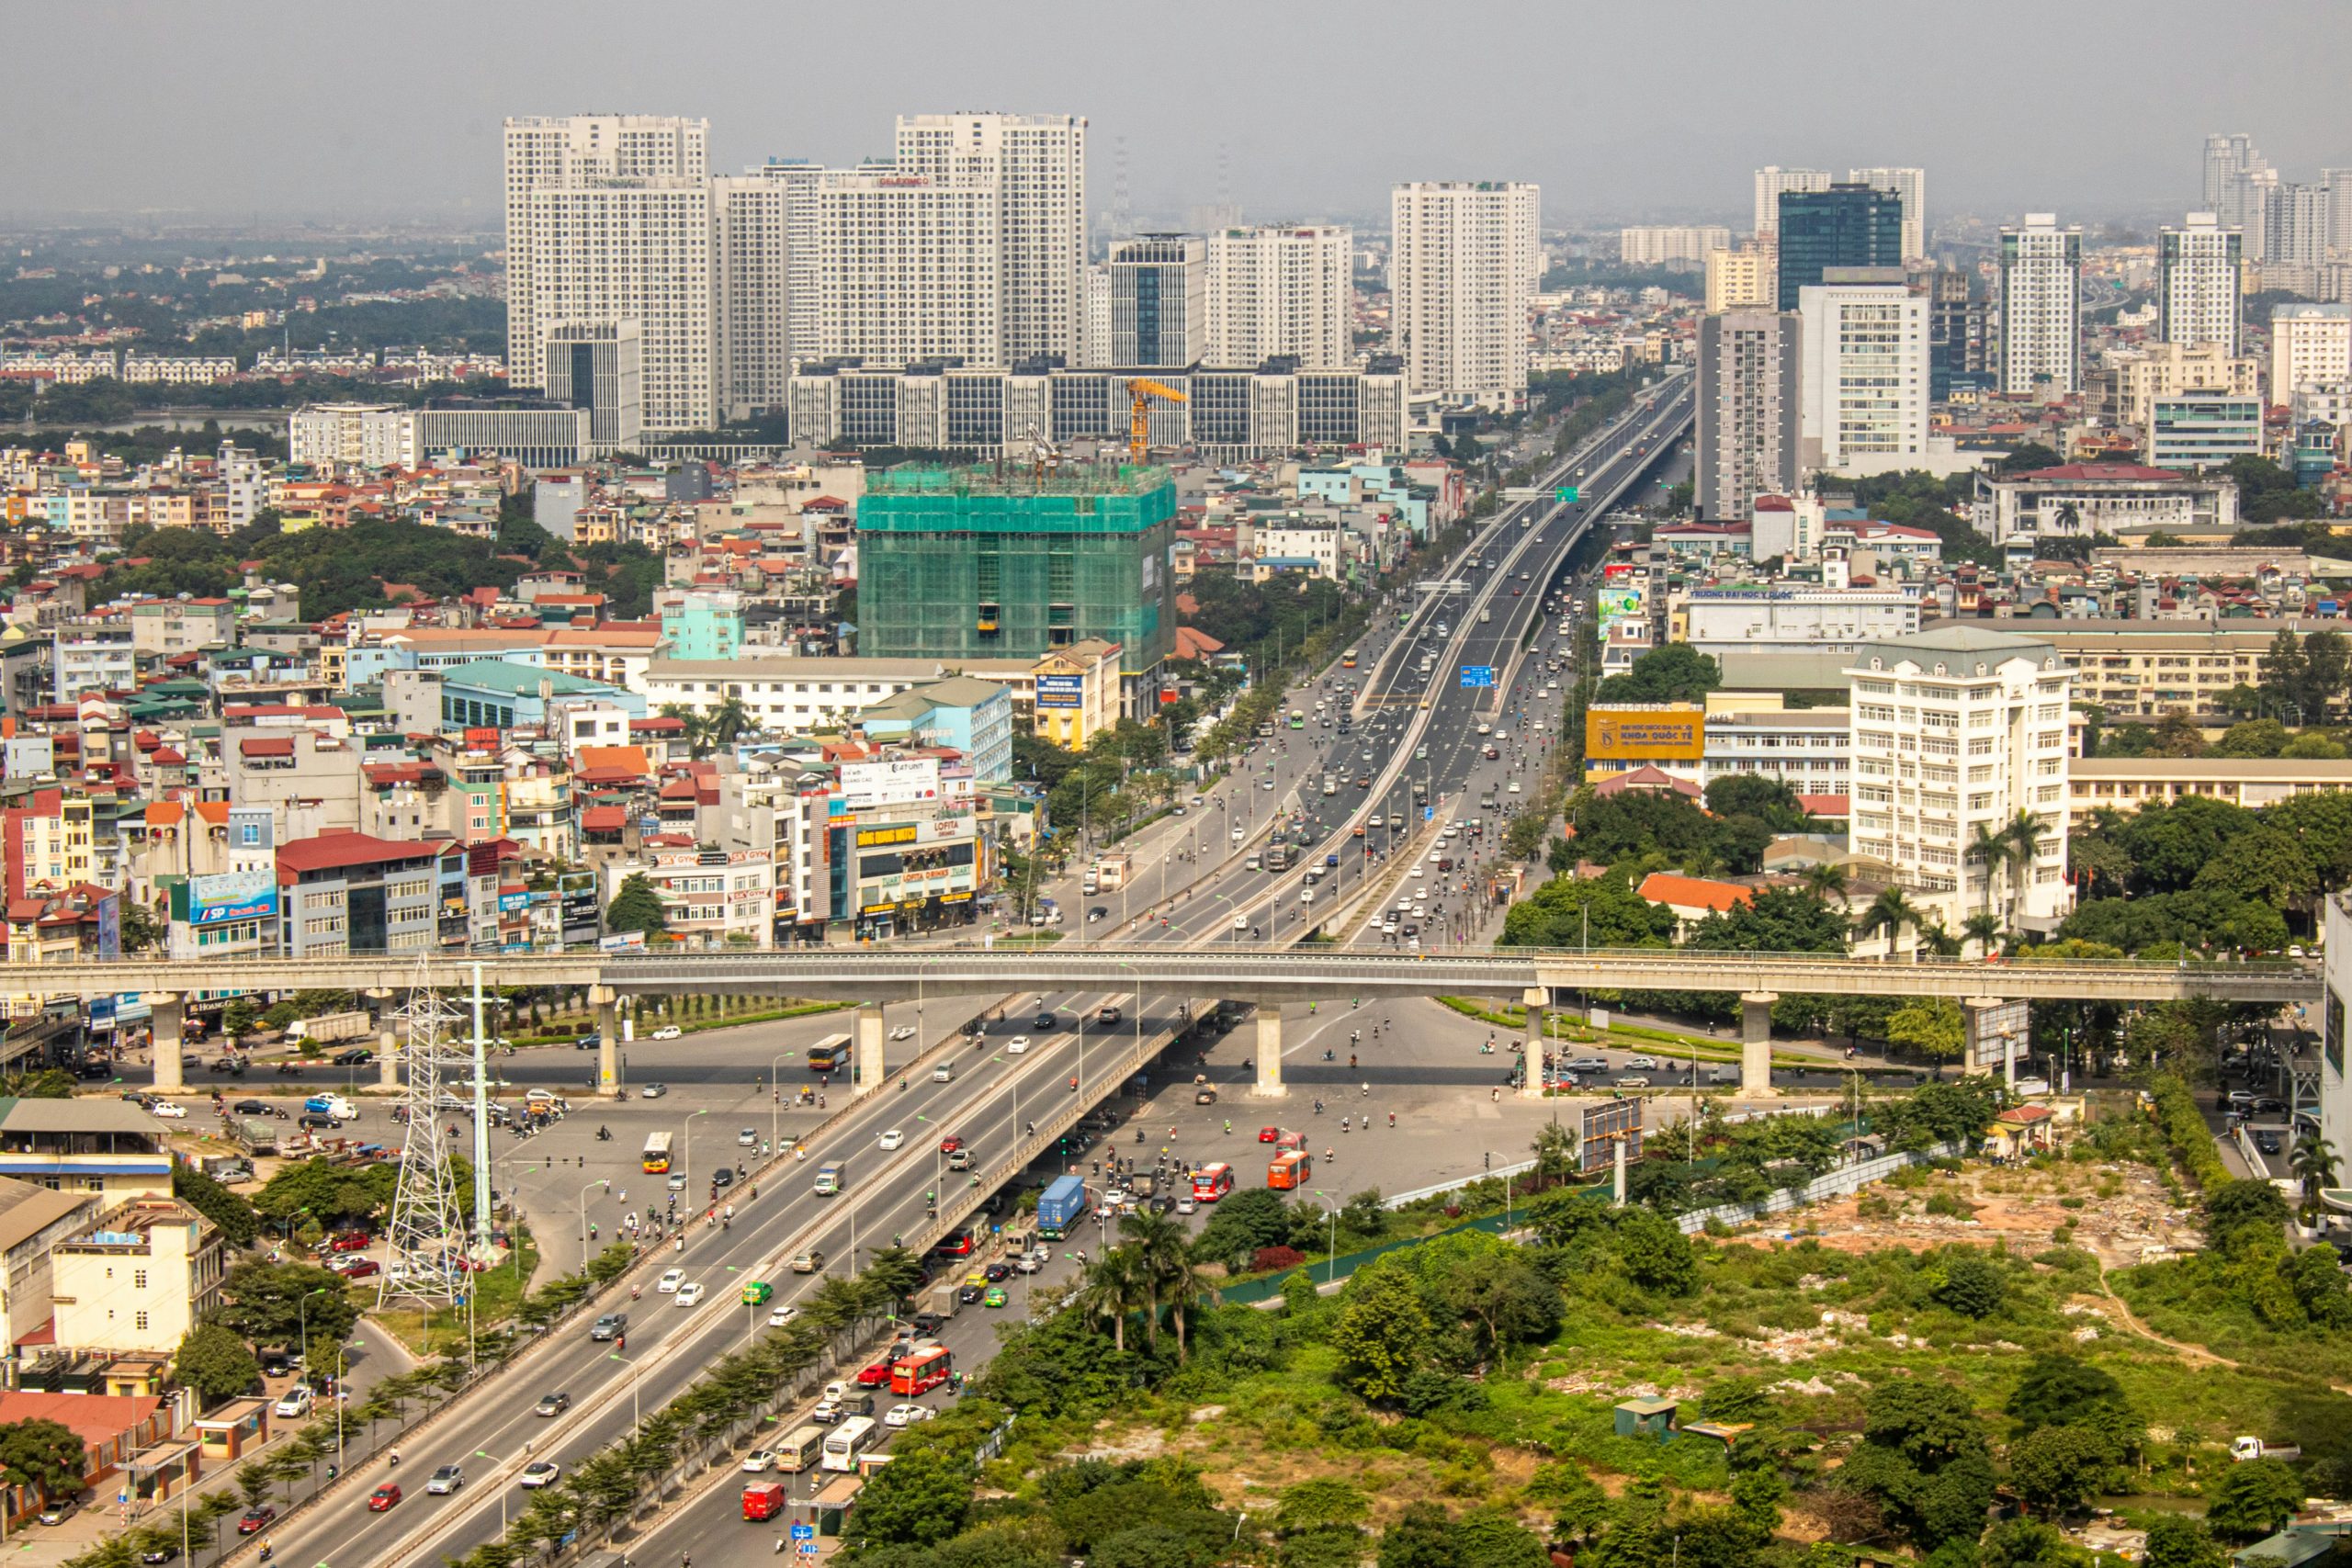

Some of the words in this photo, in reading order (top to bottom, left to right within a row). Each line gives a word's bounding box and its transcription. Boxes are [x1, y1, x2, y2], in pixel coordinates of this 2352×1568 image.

[466, 728, 500, 740] HOTEL
[1652, 730, 1678, 739] QUỐC
[934, 820, 958, 831] LOFITA
[749, 850, 768, 859] GYM
[926, 869, 949, 879] DRINKS
[210, 908, 226, 919] SP
